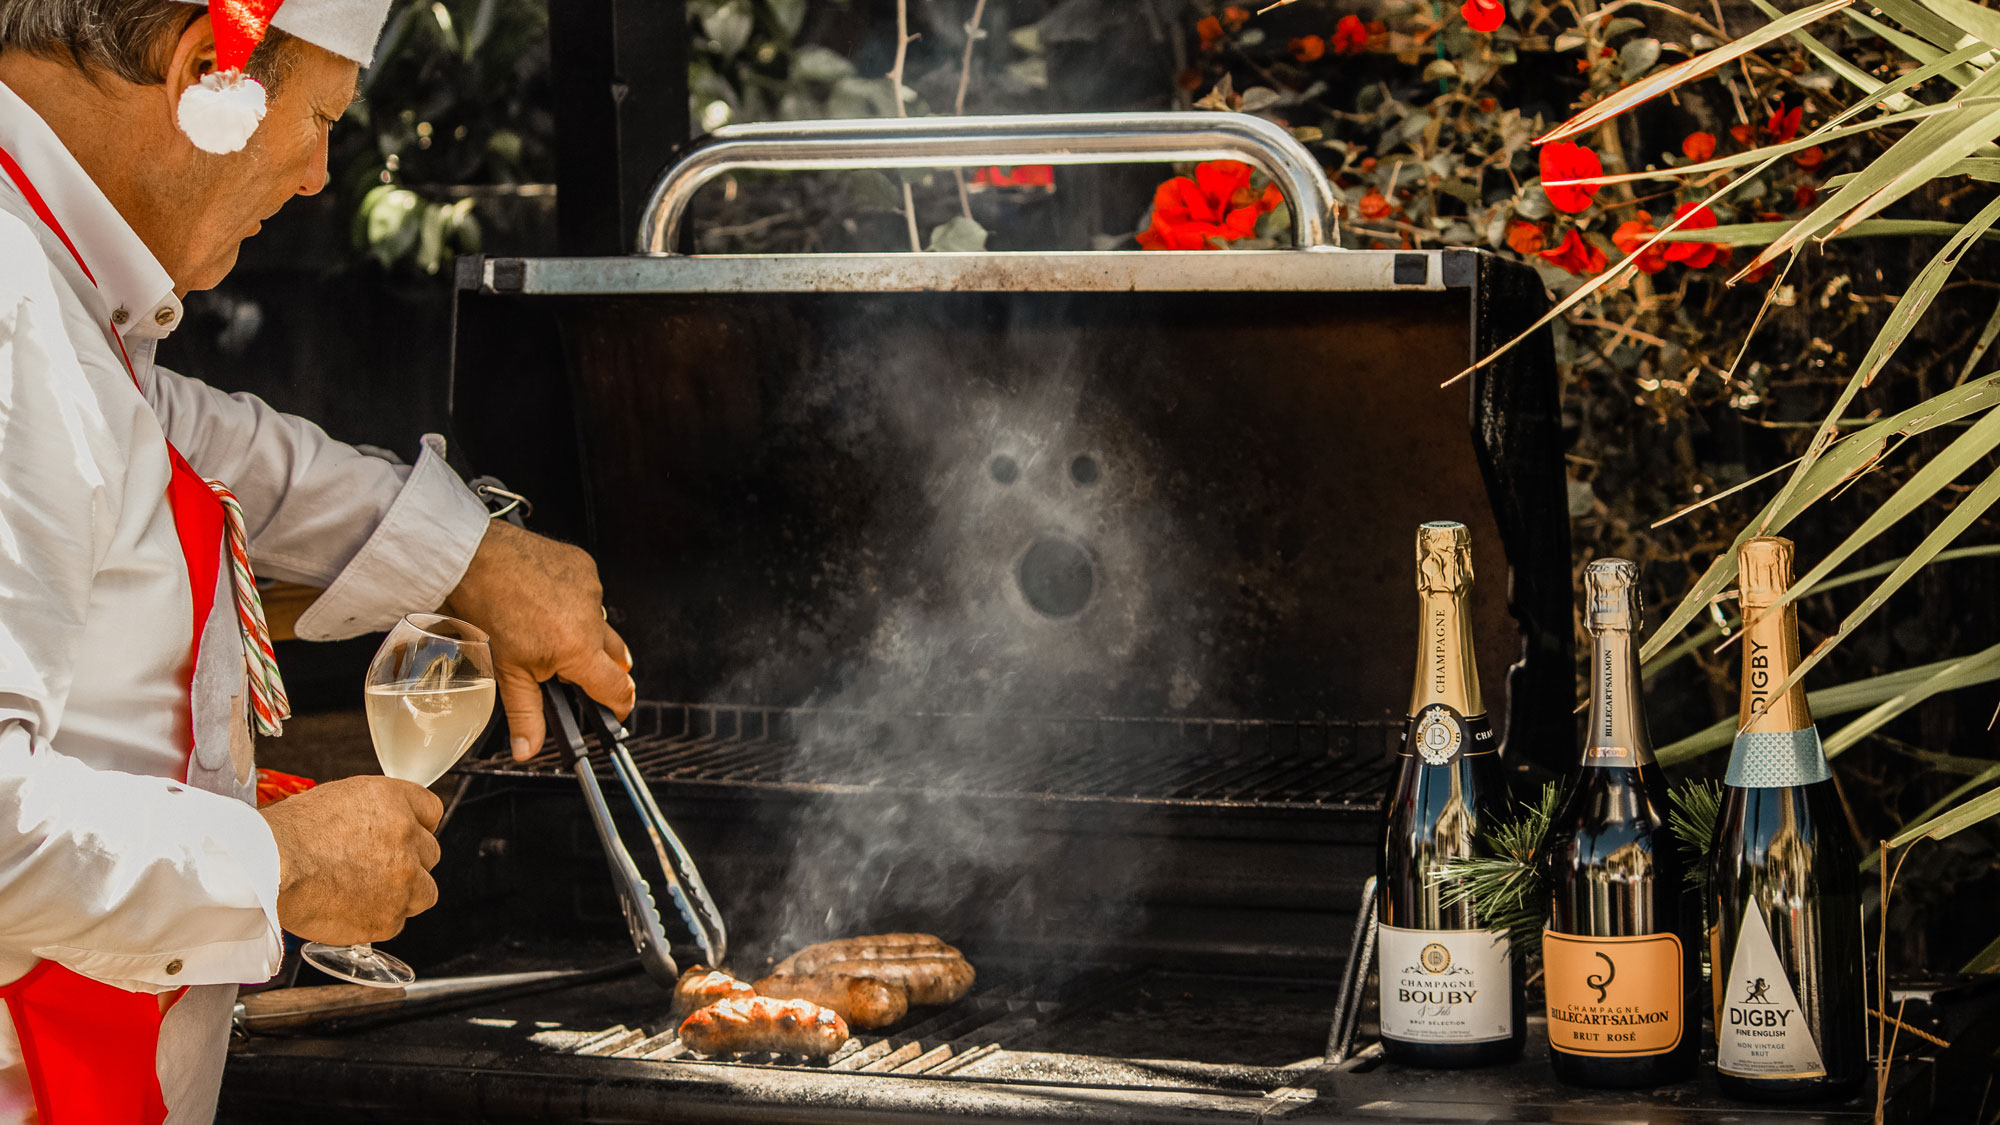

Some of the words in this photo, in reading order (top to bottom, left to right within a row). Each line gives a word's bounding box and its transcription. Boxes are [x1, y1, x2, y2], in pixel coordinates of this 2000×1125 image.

[1436, 610, 1445, 693] CHAMPAGNE
[1751, 639, 1768, 714] DIGBY
[1400, 979, 1475, 988] CHAMPAGNE
[1399, 989, 1478, 1005] BOUBY
[1551, 1008, 1669, 1026] BILLECART-SALMON
[1567, 1004, 1640, 1014] CHAMPAGNE
[1730, 1007, 1791, 1027] DIGBY
[1573, 1031, 1600, 1041] BRUT
[1607, 1031, 1636, 1042] ROSÉ
[1736, 1028, 1751, 1036] FINE
[1753, 1029, 1786, 1037] ENGLISH
